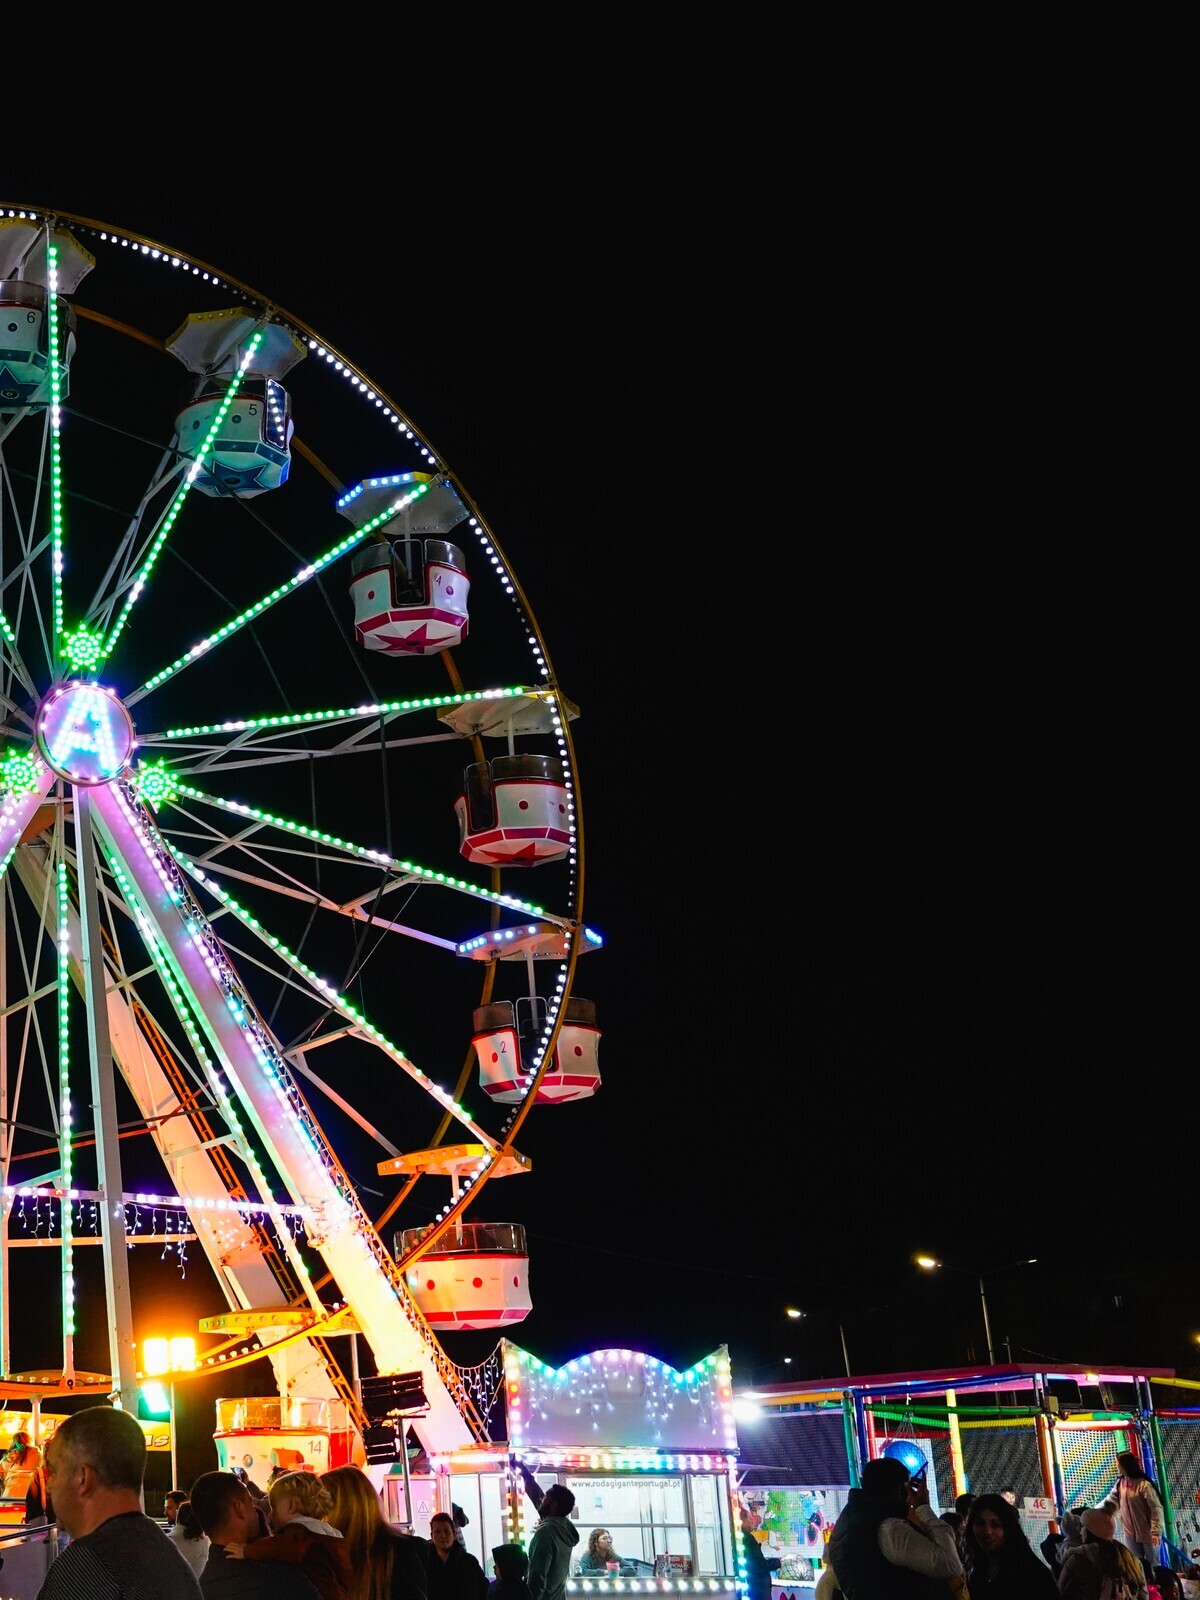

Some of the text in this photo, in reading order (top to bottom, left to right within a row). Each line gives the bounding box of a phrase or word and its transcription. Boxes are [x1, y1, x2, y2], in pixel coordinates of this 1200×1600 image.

[27, 311, 36, 324] 6
[249, 403, 258, 416] 5
[435, 575, 442, 587] 4
[50, 687, 118, 771] A
[500, 1040, 507, 1054] 2
[308, 1440, 323, 1454] 14
[571, 1480, 681, 1489] www.rodagiganteportugal.pt
[1033, 1498, 1047, 1510] 4€
